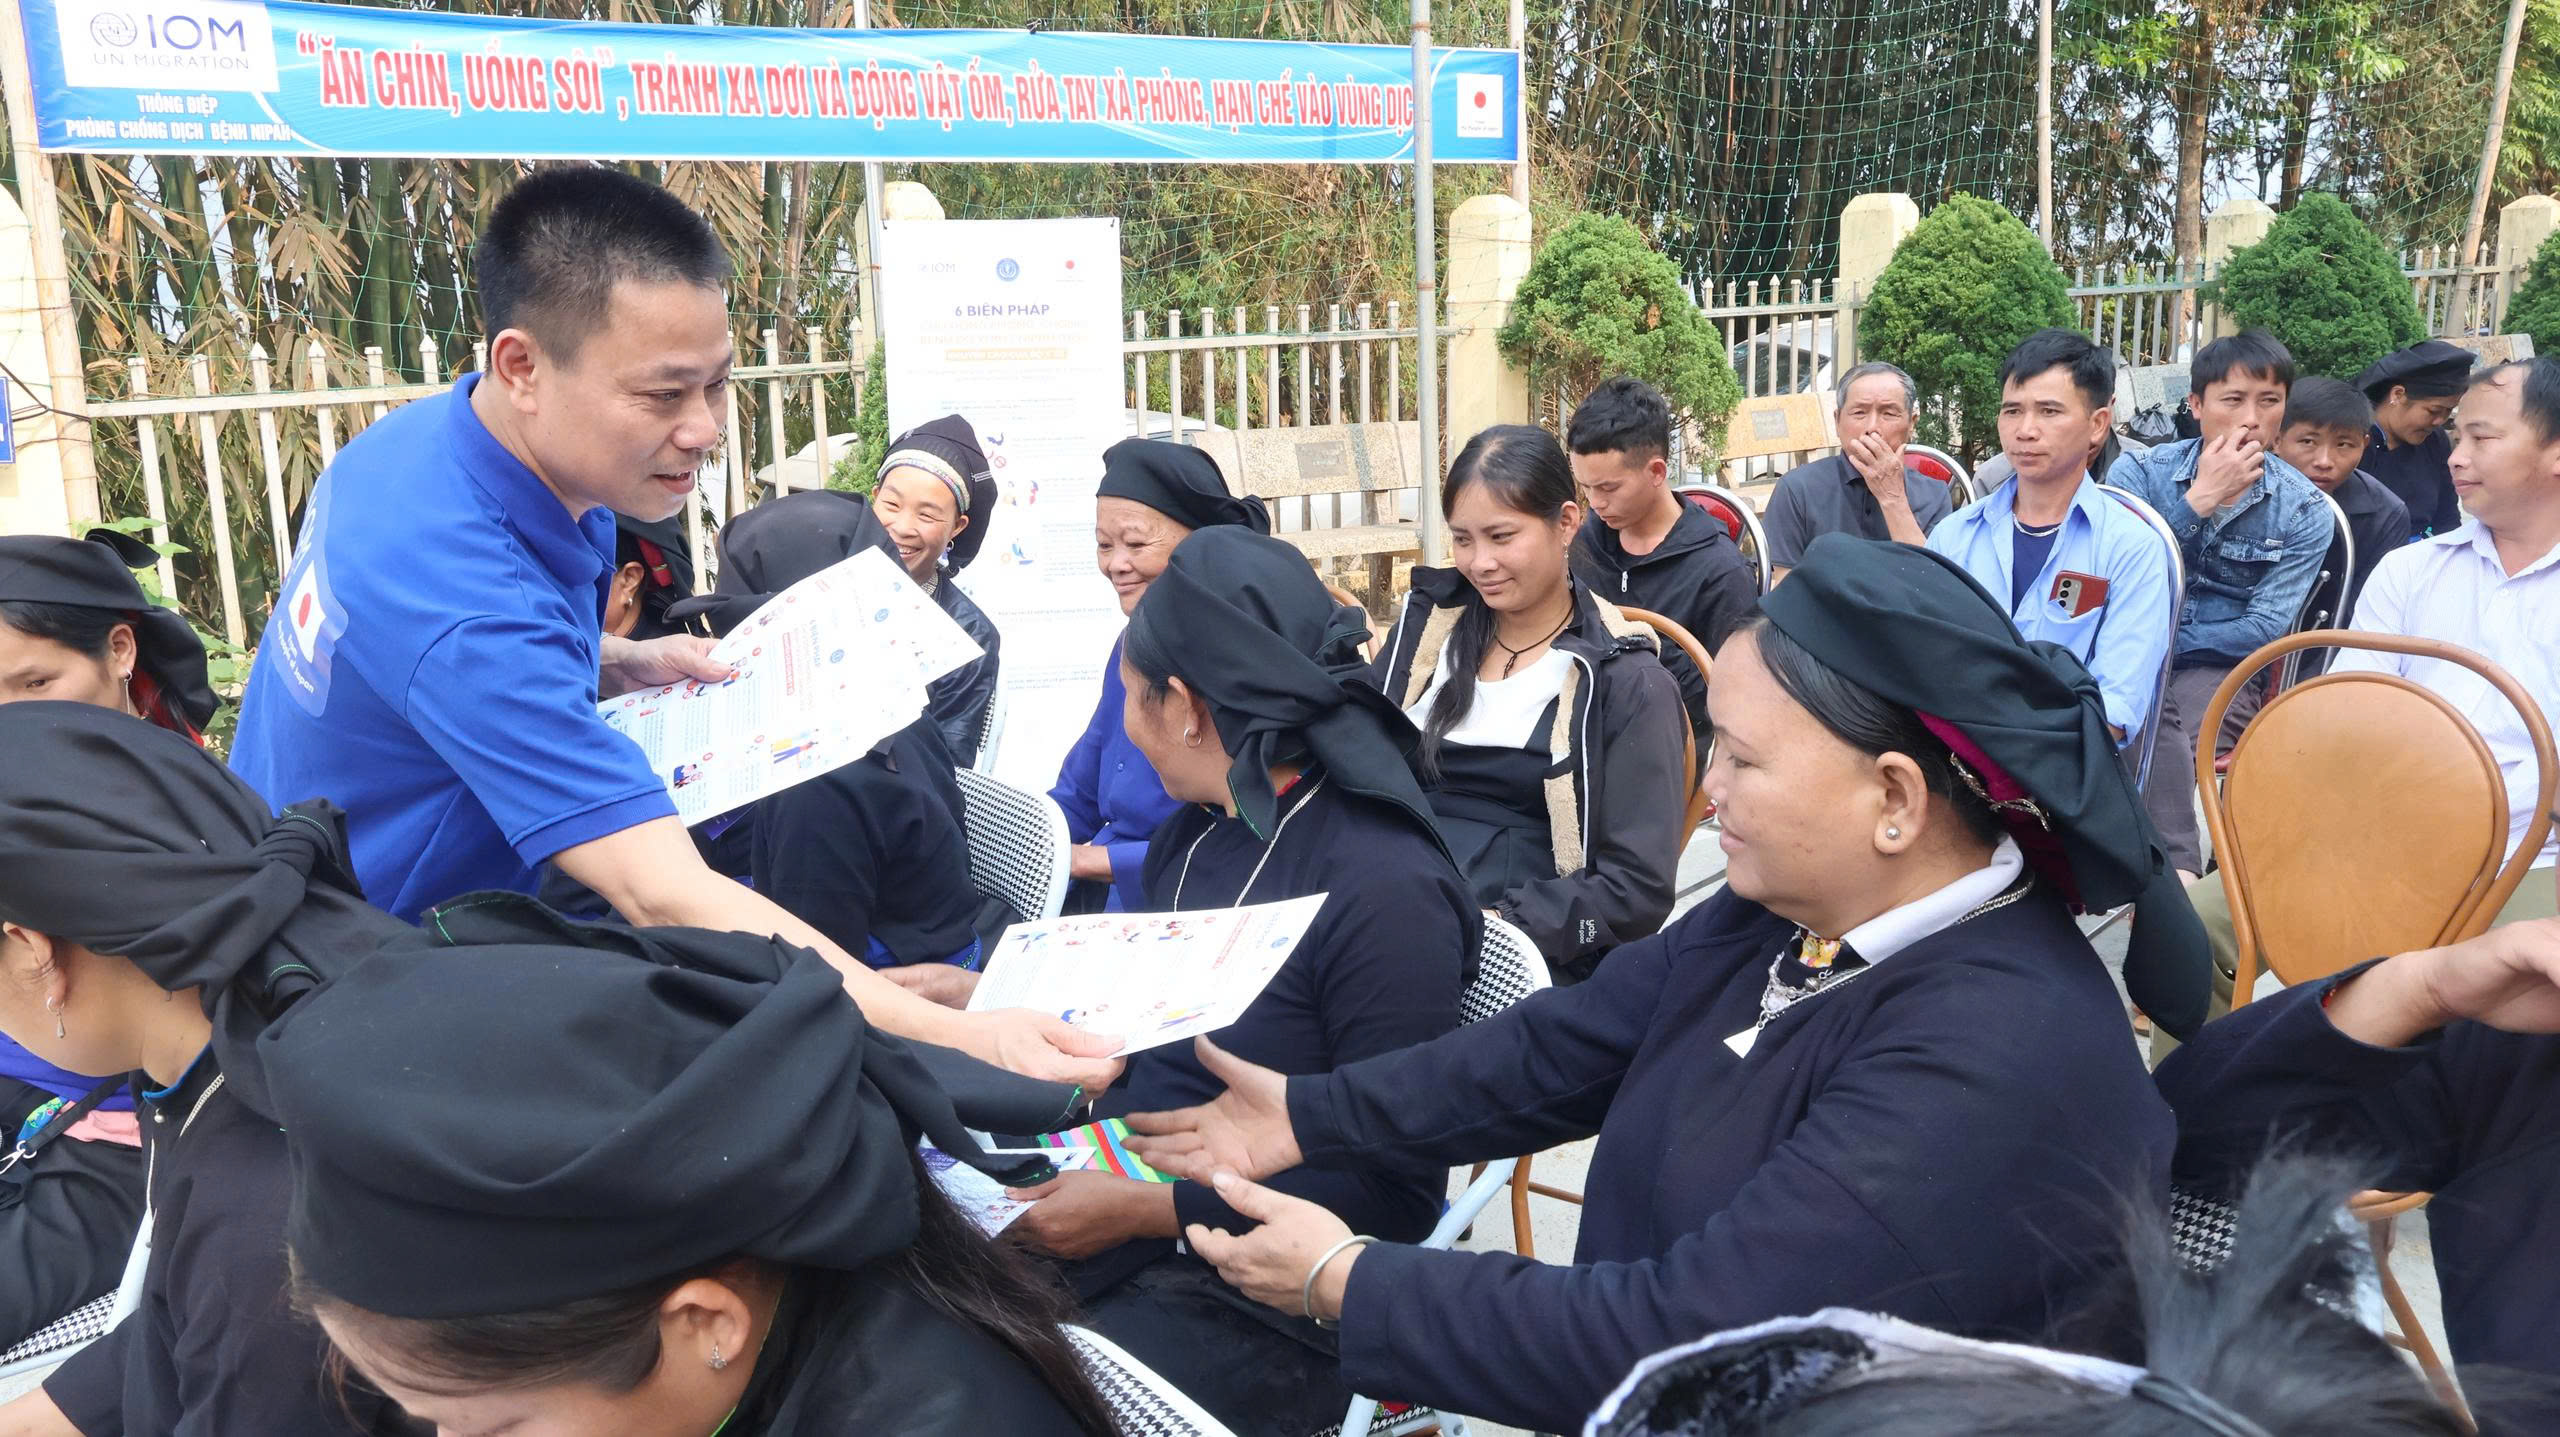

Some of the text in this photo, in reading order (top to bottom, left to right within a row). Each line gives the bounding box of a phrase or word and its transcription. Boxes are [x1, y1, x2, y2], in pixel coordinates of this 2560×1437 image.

[147, 14, 247, 51] IOM
[93, 53, 249, 70] UN MIGRATION
[298, 32, 368, 105] “ĂN
[373, 42, 460, 116] CHÍN,
[464, 38, 548, 111] UỐNG
[724, 65, 762, 115] XA
[765, 63, 810, 116] DƠI
[812, 57, 848, 117] VÀ
[850, 59, 918, 129] ĐỘNG
[919, 62, 963, 129] VẬT
[968, 56, 1014, 126] ỐM,
[1015, 59, 1061, 121] RỬA
[1062, 76, 1098, 121] TAY
[1102, 68, 1133, 122] XÀ
[1135, 68, 1209, 129] PHÒNG,
[1212, 80, 1254, 134] HẠN
[1257, 68, 1294, 124] CHẾ
[1296, 74, 1332, 126] VÀO
[1335, 76, 1382, 127] VÙNG
[1385, 85, 1414, 136] DỊC
[136, 92, 219, 117] THÔNG ĐIỆP
[65, 116, 117, 138] PHÒNG
[119, 116, 169, 140] CHỐNG
[170, 121, 204, 143] DỊCH
[210, 119, 248, 144] BỆNH
[955, 305, 962, 317] 6
